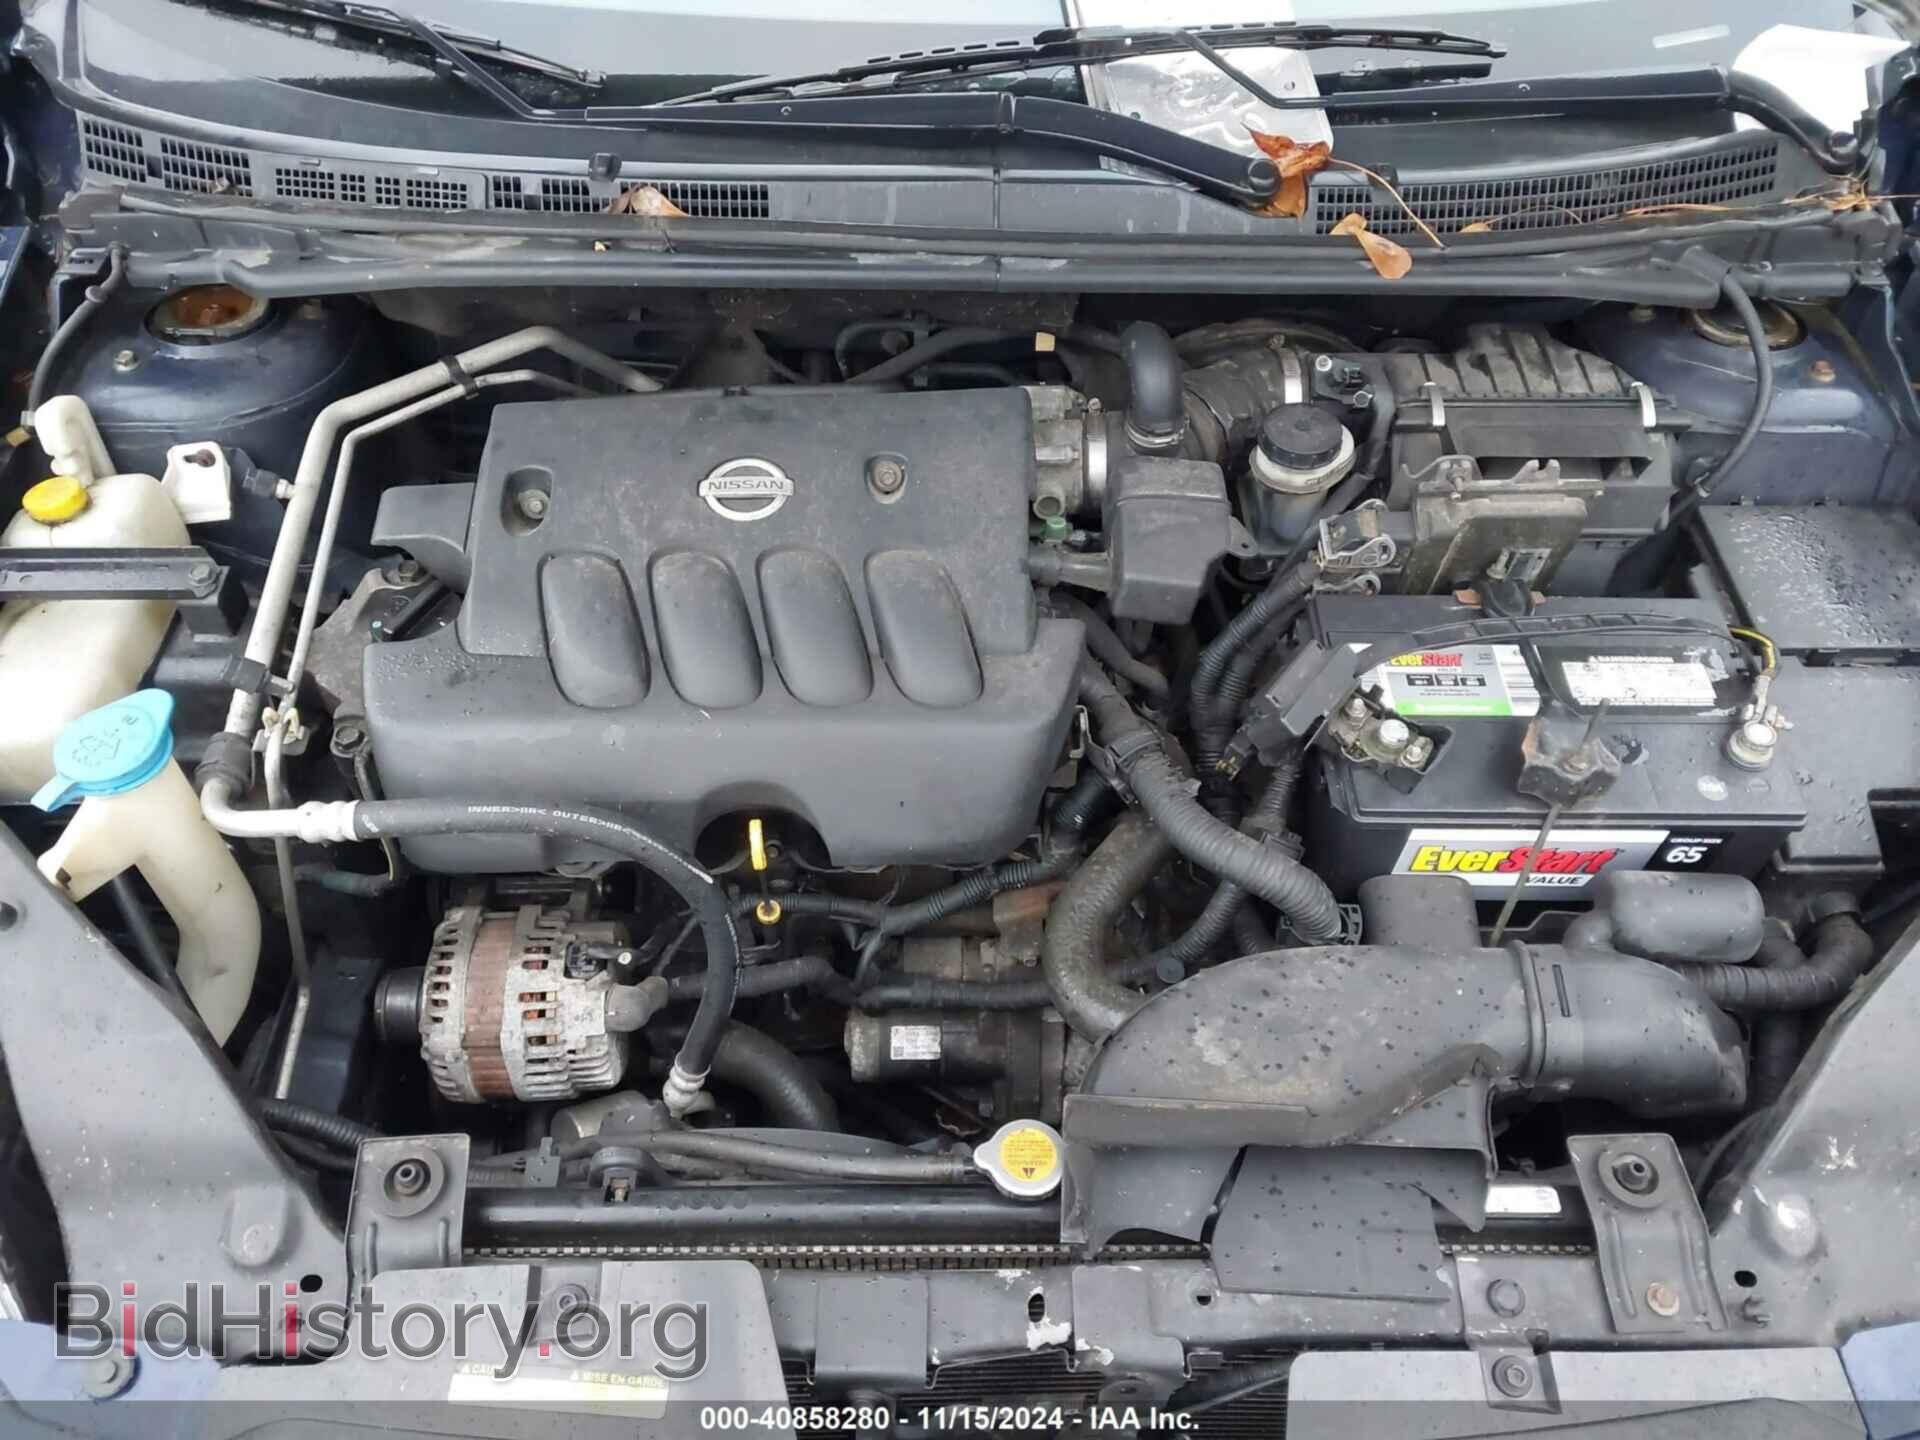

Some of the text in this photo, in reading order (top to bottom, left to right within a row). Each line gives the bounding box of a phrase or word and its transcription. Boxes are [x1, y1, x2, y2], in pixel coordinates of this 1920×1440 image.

[708, 479, 784, 491] NISSAN
[1409, 845, 1619, 874] EverStart
[1666, 846, 1708, 863] 65
[1528, 875, 1584, 885] VALUE
